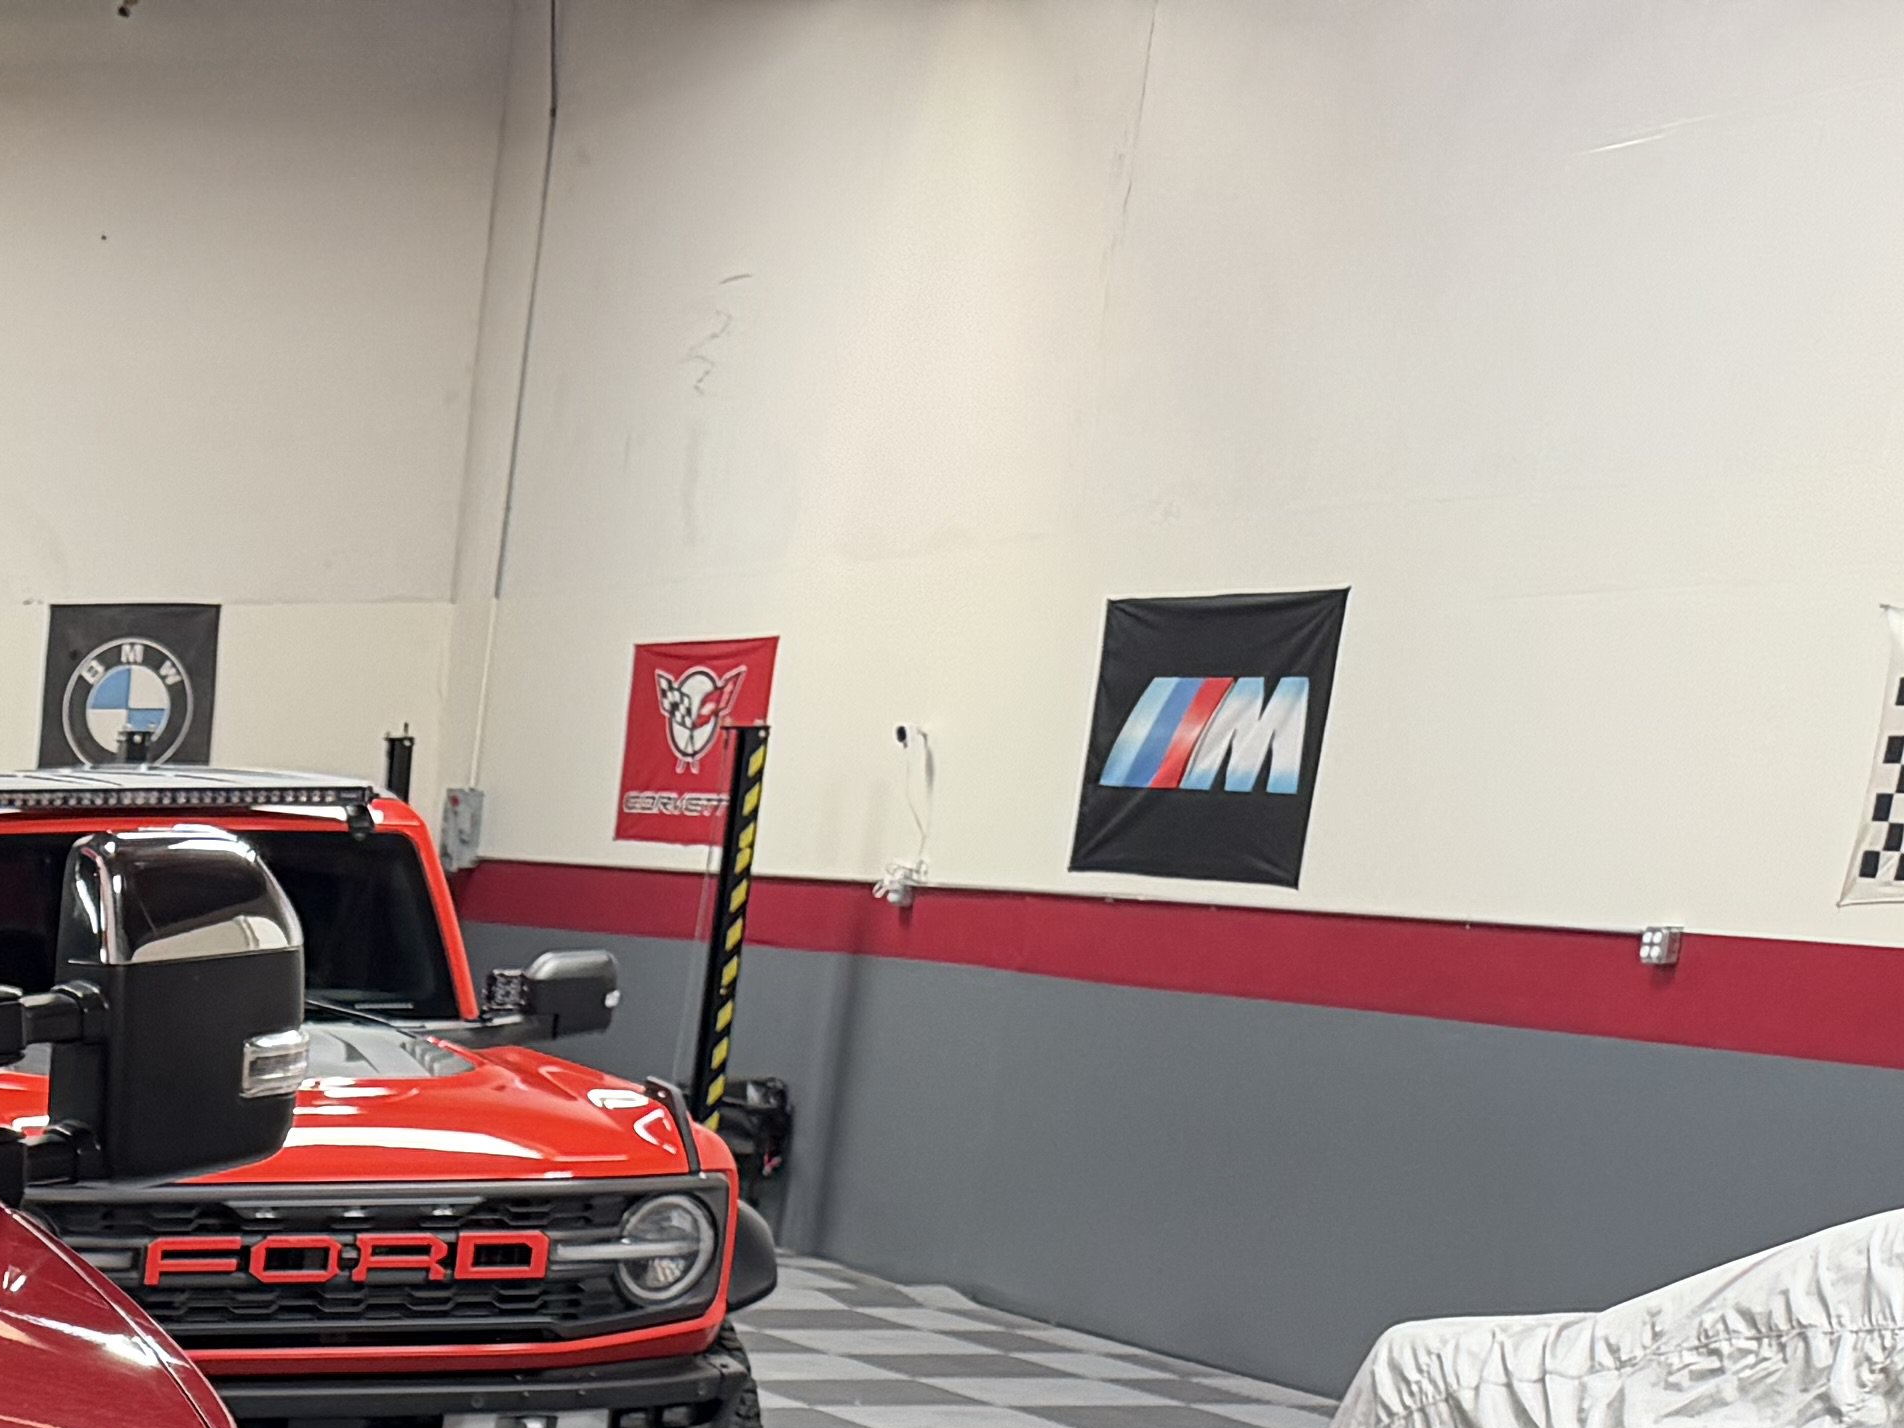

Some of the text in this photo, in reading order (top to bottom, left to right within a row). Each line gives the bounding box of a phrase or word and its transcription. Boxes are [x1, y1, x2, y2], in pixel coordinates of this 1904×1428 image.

[80, 643, 182, 685] BMW
[623, 790, 730, 817] CORVETT
[144, 1230, 550, 1285] FORD
